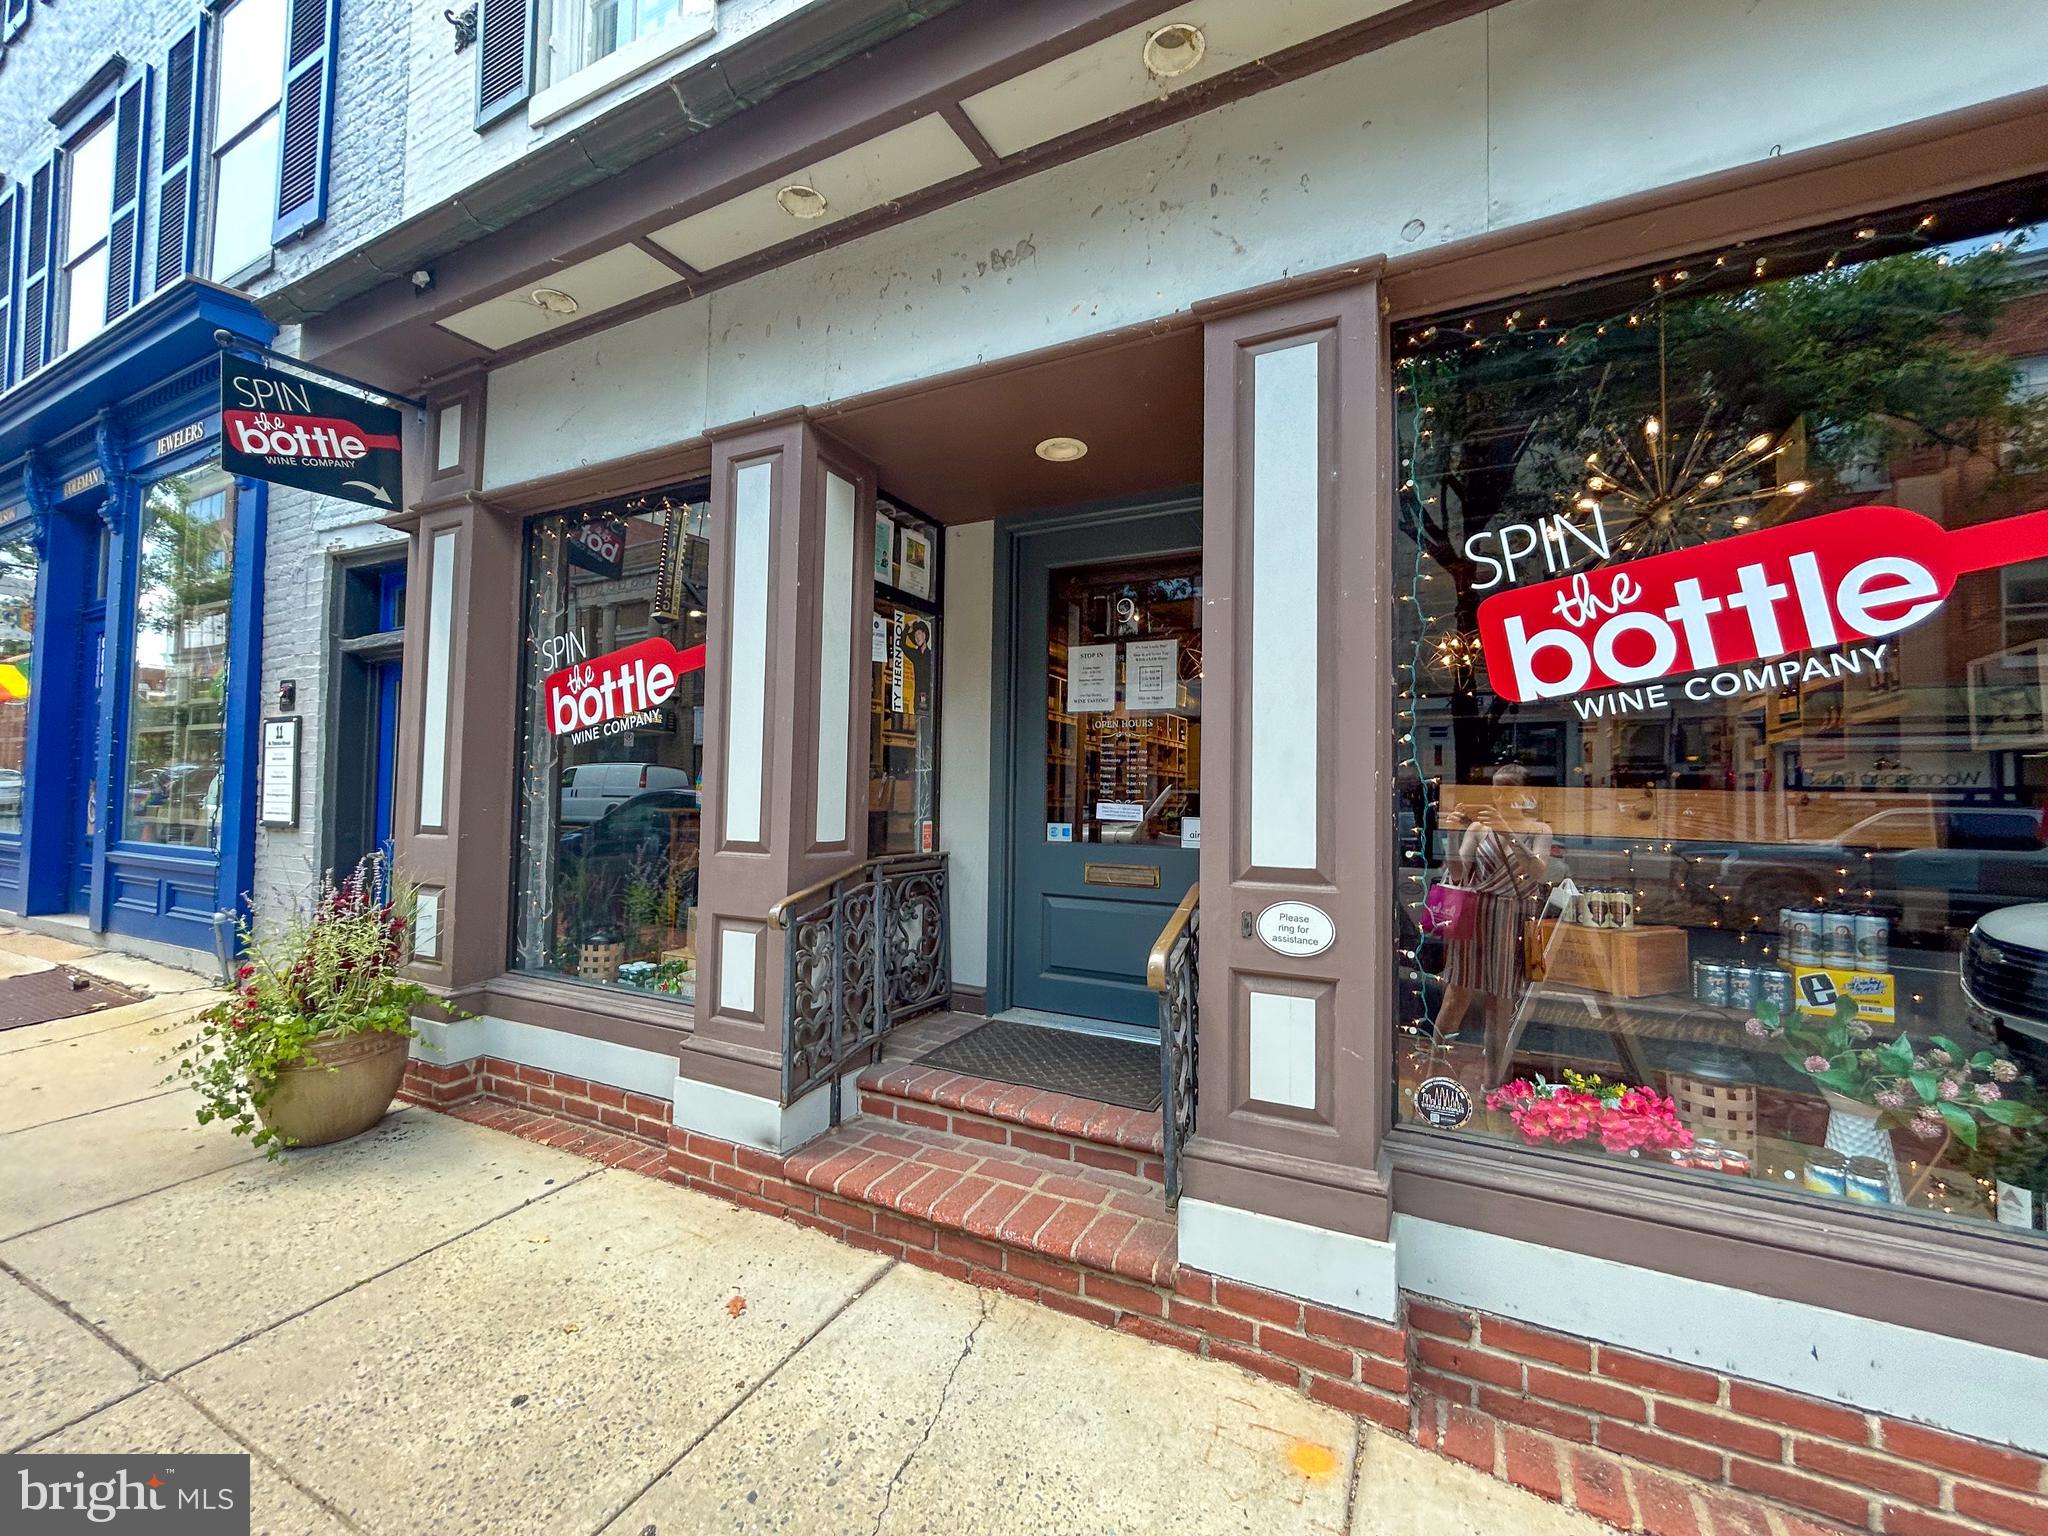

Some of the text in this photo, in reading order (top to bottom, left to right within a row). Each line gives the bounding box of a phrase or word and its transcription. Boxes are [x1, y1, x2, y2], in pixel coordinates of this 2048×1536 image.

[233, 376, 311, 413] SPIN
[156, 422, 205, 456] JEWELERS
[254, 412, 285, 431] the
[234, 420, 368, 459] bottle
[264, 455, 356, 469] WINE COMPANY
[1463, 502, 1611, 590] SPIN
[1117, 598, 1135, 622] 9
[1551, 572, 1641, 628] the
[1502, 550, 1944, 703] bottle
[542, 626, 587, 672] SPIN
[893, 613, 904, 710] TY HERNDON
[552, 658, 676, 736] bottle
[567, 664, 595, 695] the
[1572, 642, 1888, 720] WINE COMPANY
[276, 725, 284, 739] 11
[570, 727, 600, 746] WINE
[603, 708, 660, 737] COMPANY
[1095, 719, 1154, 729] OPEN HOURS
[1278, 925, 1310, 935] ring for
[1279, 912, 1310, 924] Please
[1271, 935, 1319, 946] assistance
